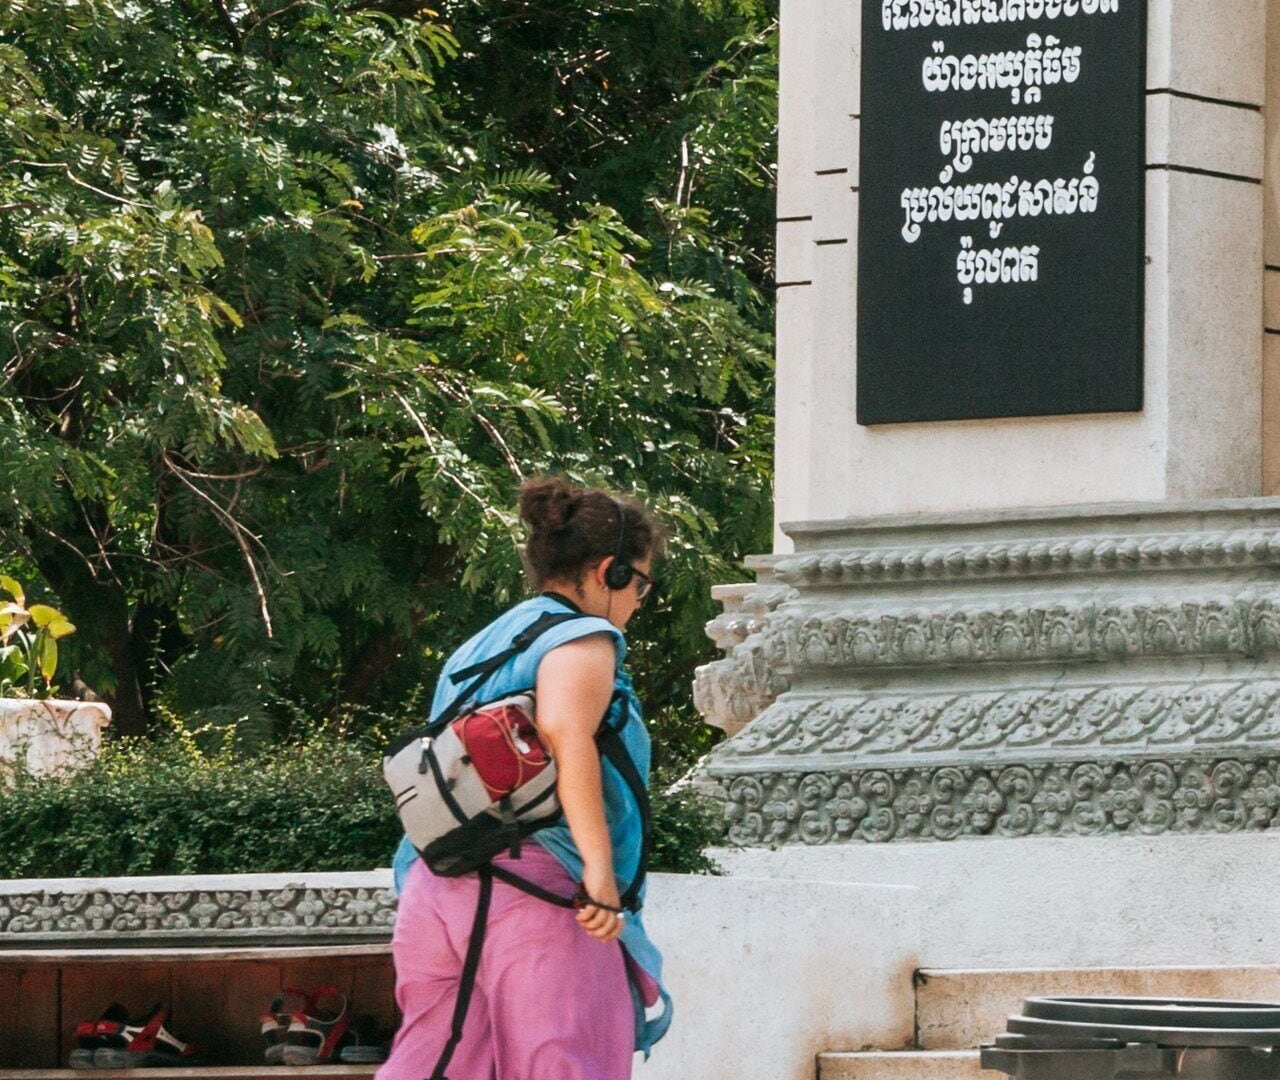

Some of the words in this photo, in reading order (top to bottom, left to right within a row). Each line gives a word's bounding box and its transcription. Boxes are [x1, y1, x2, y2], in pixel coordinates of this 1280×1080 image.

[939, 114, 1055, 174] ក្រោមរបប
[957, 235, 1041, 305] ប៉ុលពត
